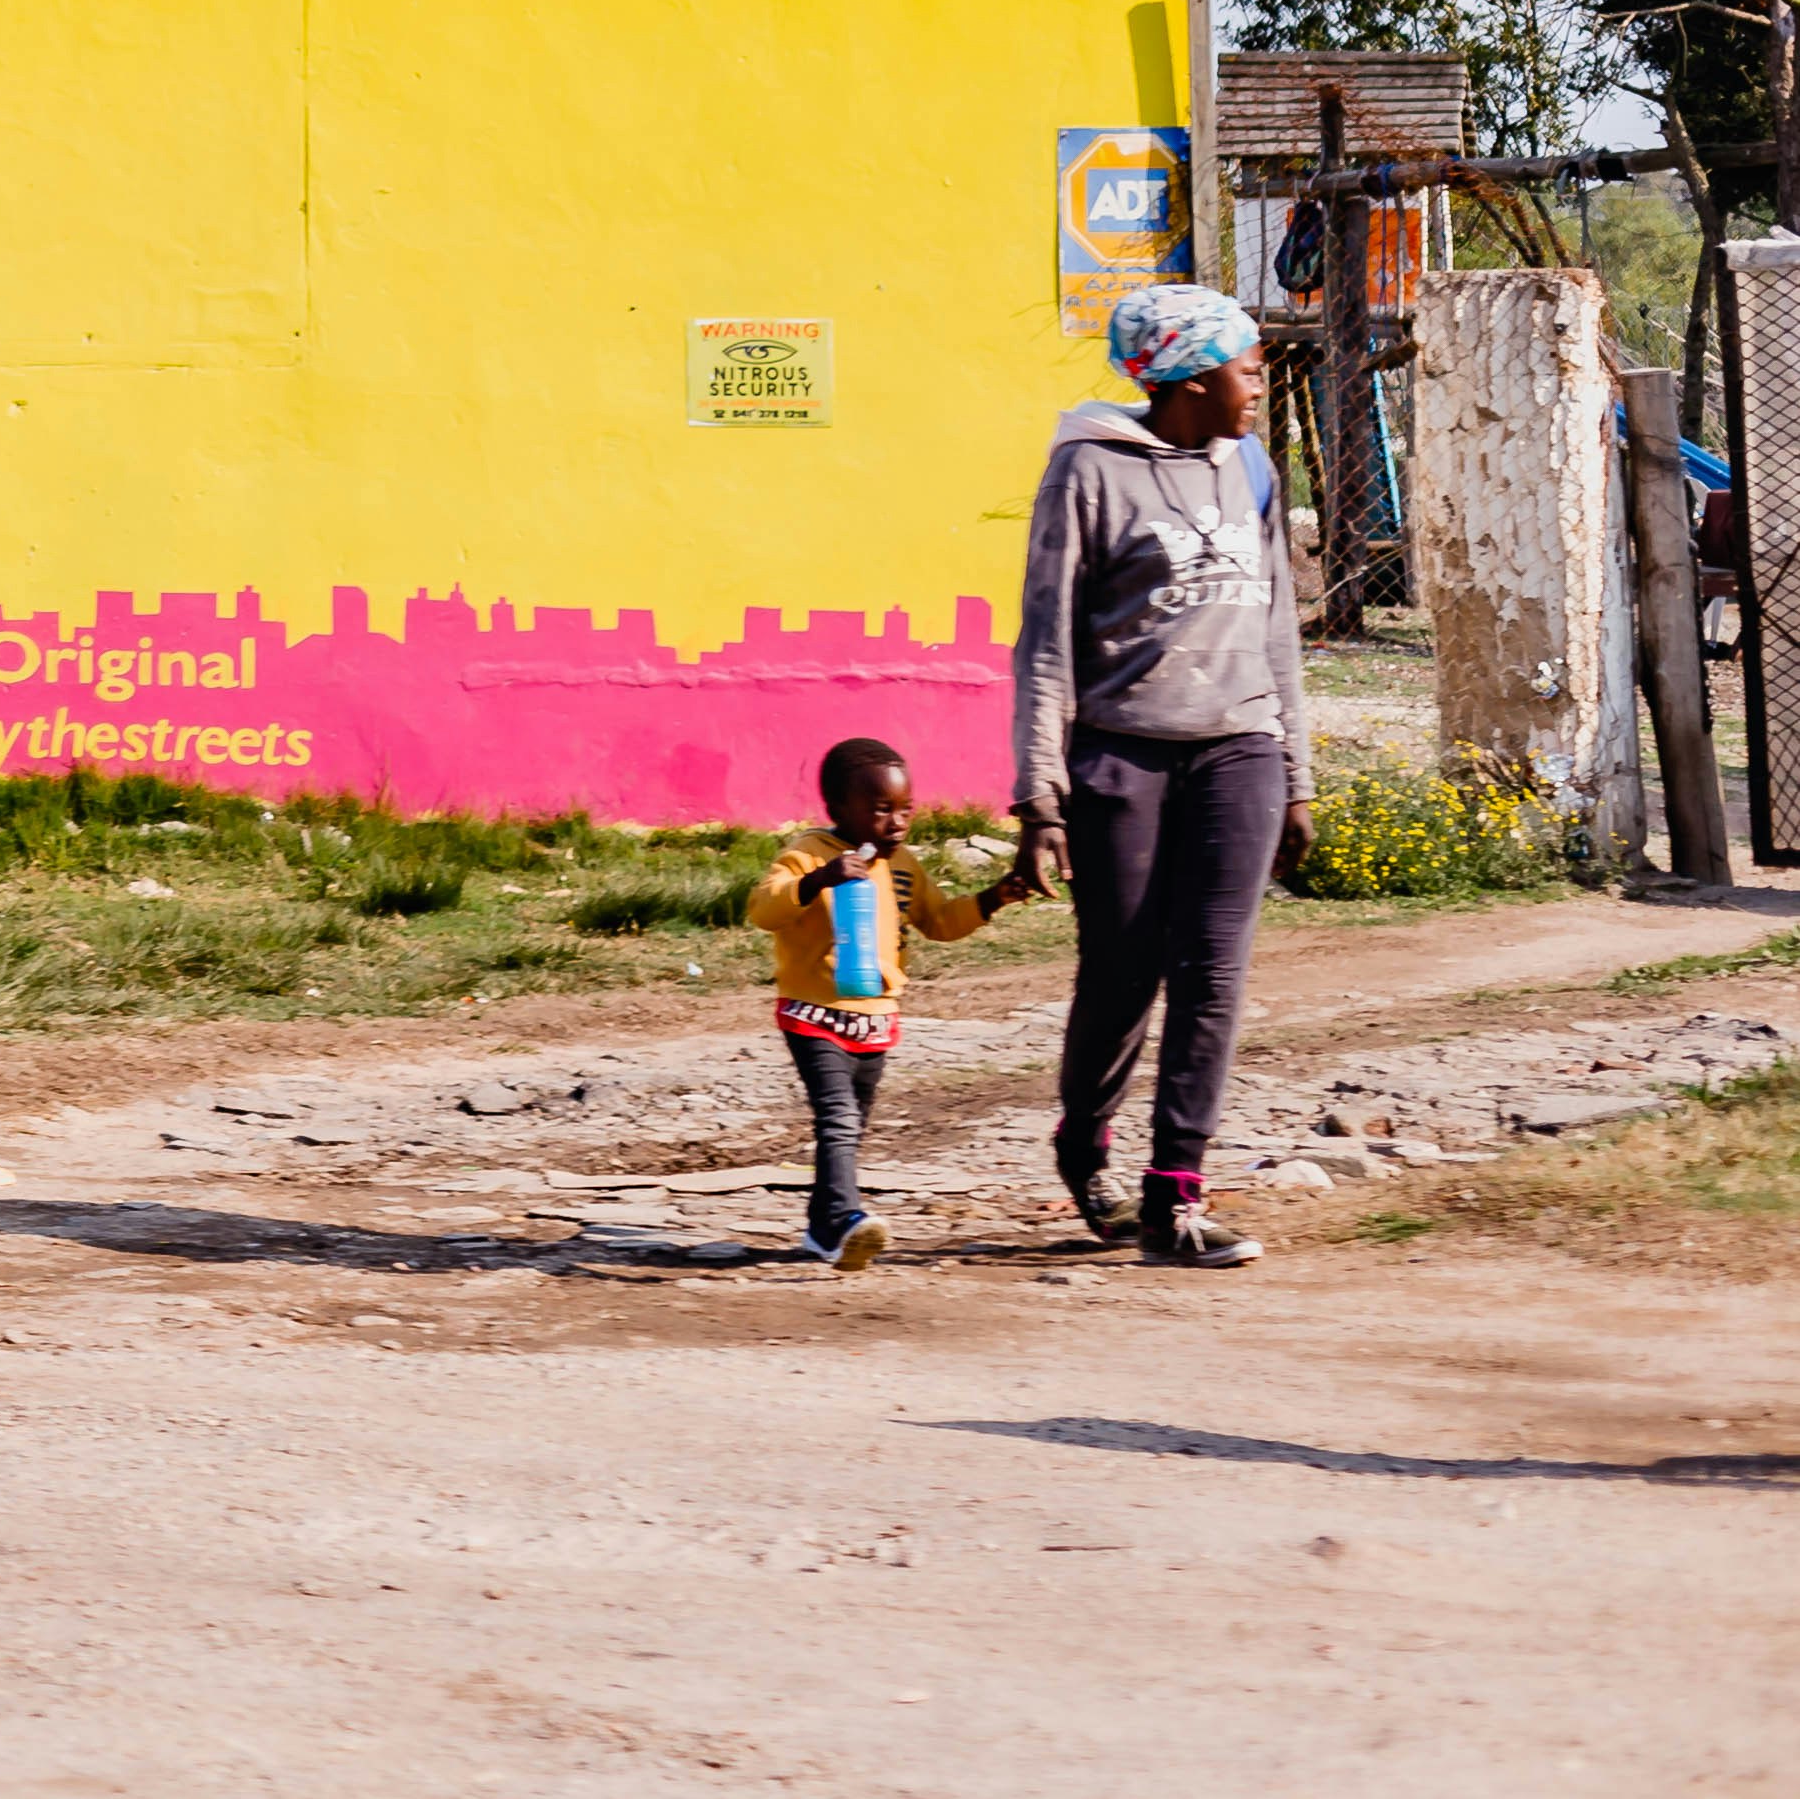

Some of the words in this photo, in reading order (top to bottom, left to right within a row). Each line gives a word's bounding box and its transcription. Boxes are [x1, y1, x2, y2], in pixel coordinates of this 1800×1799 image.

[1089, 180, 1168, 221] ADT
[701, 323, 819, 338] WARNING
[714, 366, 808, 381] NITROUS
[709, 382, 813, 397] SECURITY
